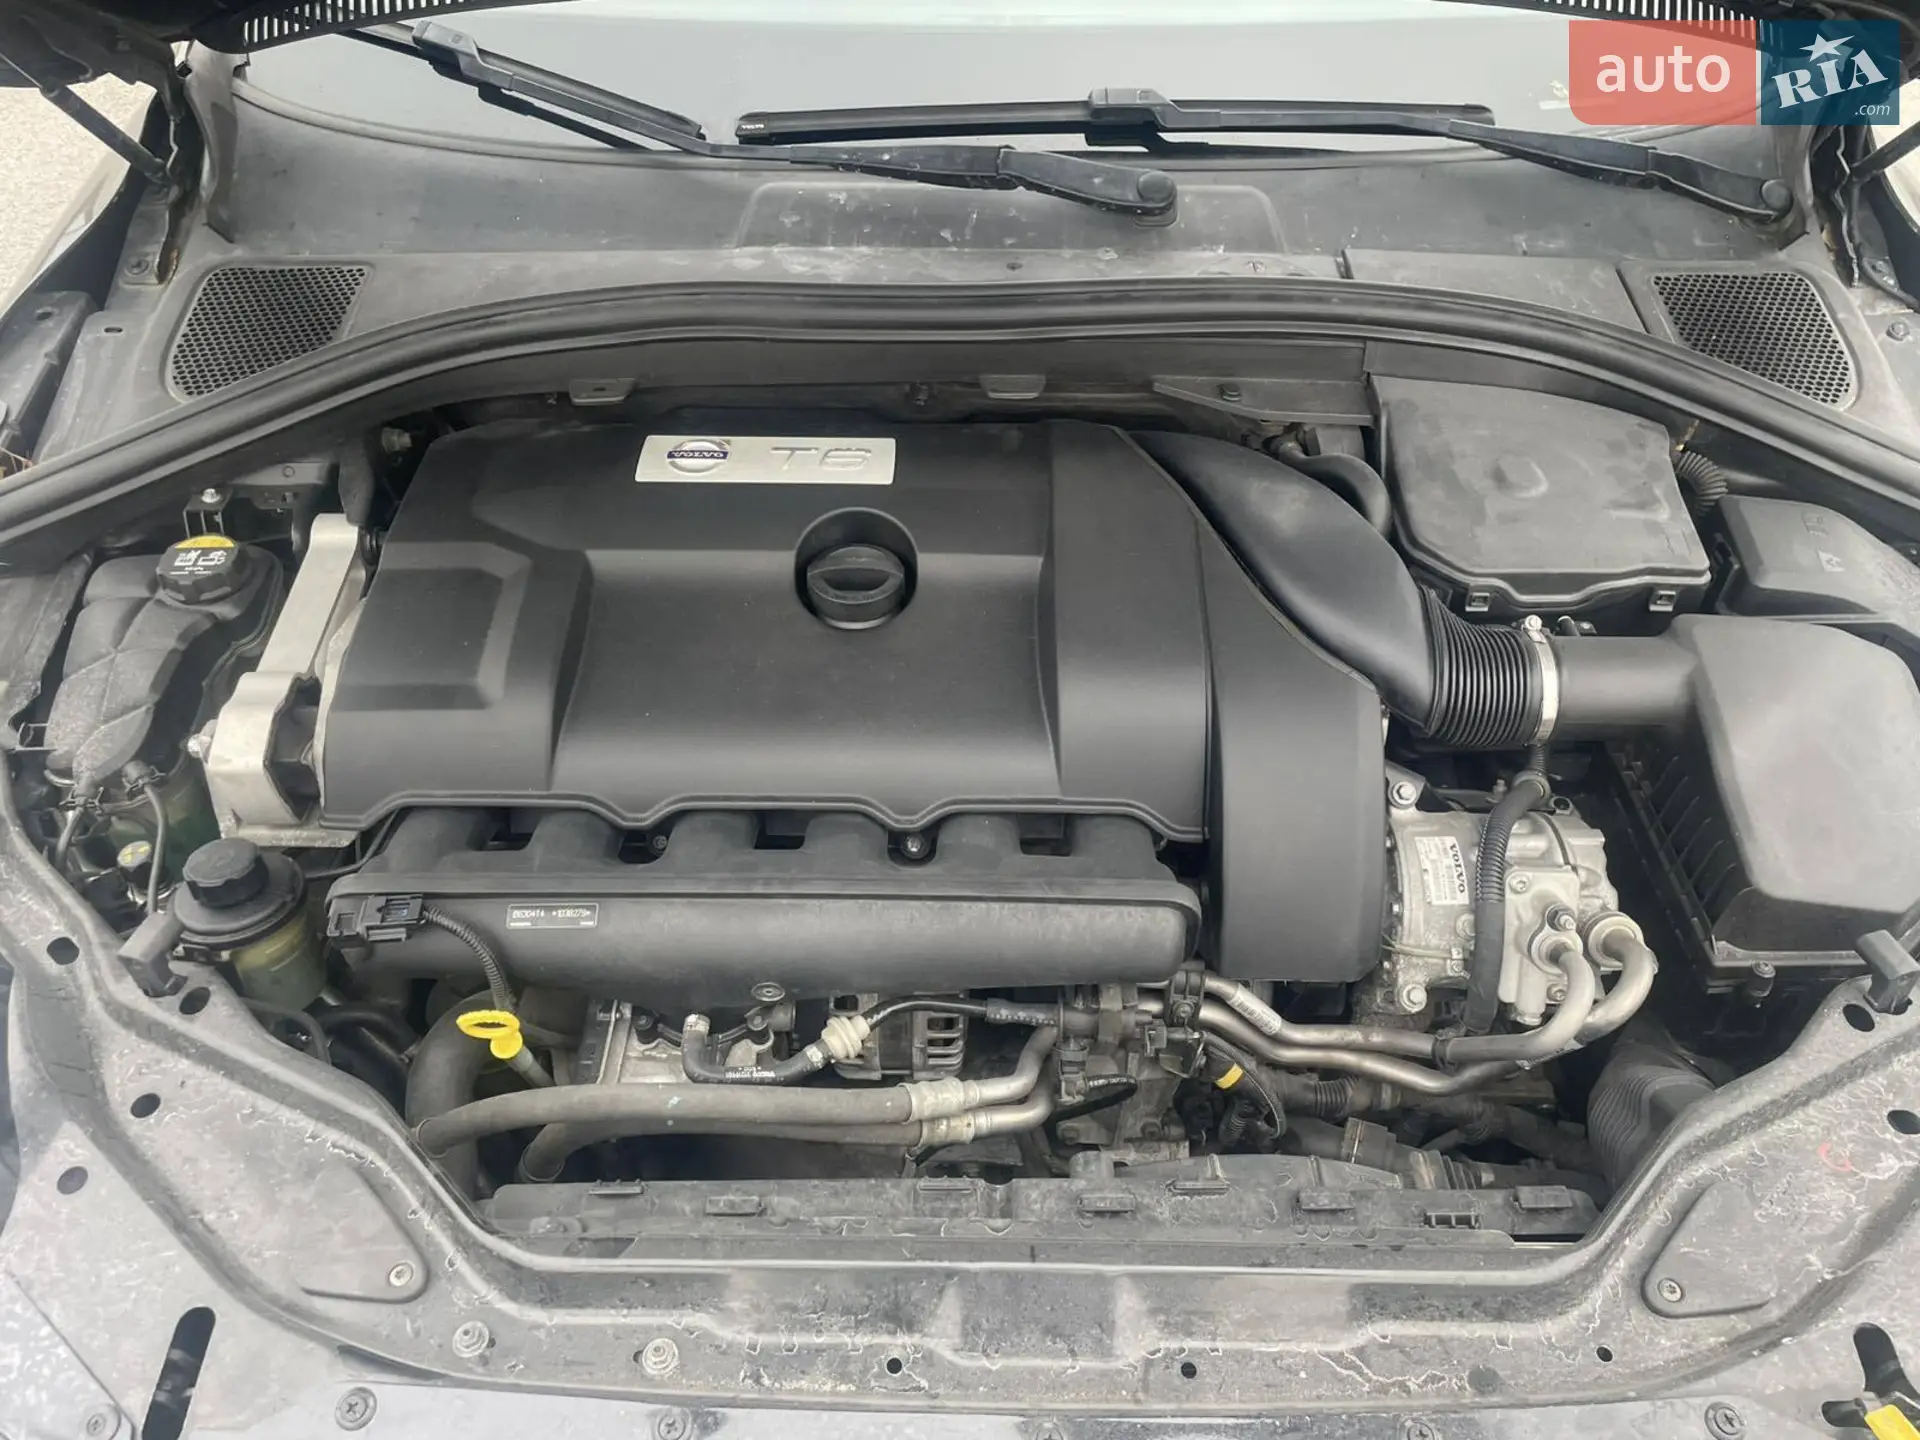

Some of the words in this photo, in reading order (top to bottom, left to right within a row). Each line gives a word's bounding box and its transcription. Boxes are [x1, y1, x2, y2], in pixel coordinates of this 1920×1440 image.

[670, 451, 725, 459] VOLVO
[770, 446, 873, 471] T6
[1449, 843, 1466, 894] VOLVO
